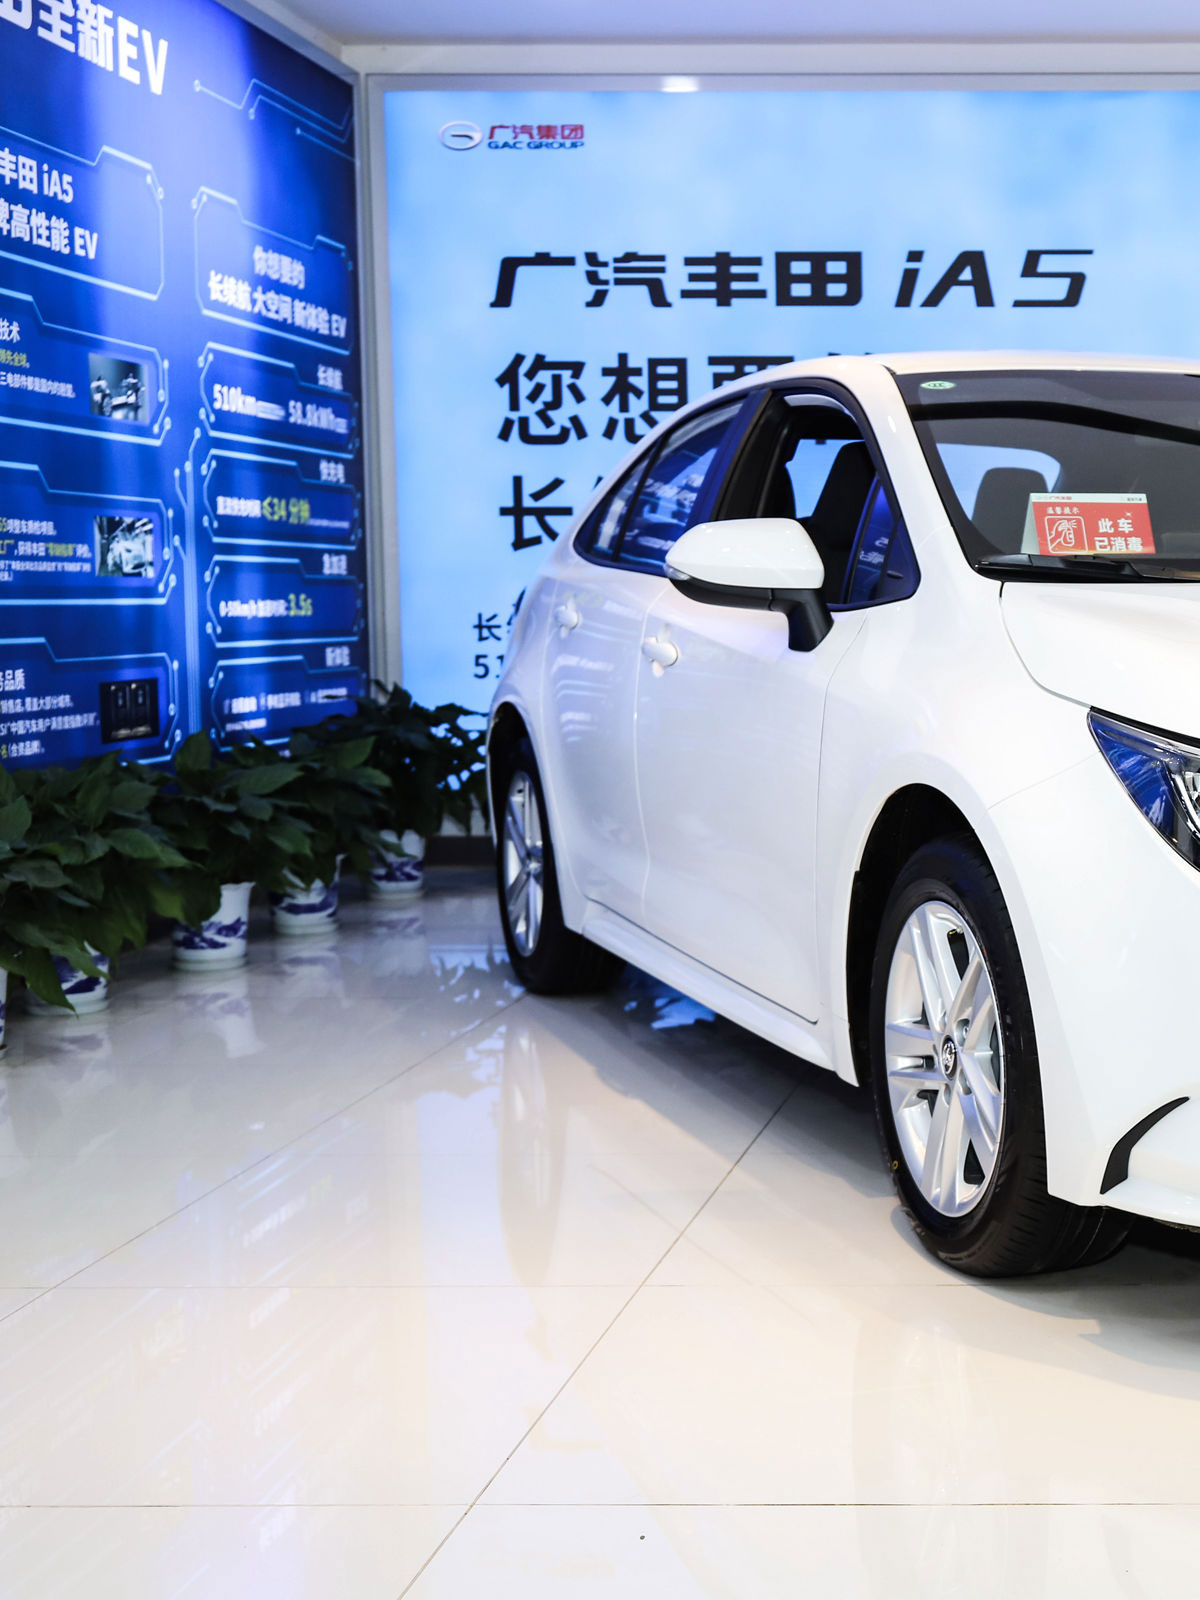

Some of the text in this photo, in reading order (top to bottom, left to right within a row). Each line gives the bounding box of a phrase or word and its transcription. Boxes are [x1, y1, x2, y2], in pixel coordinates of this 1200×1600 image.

[487, 140, 584, 150] GAC GROUP
[488, 124, 584, 140] 广汽集团
[42, 163, 74, 203] iA5
[74, 226, 98, 260] EV
[490, 248, 1094, 308] 广汽丰田 iA5
[495, 353, 793, 445] 您想
[1094, 536, 1144, 552] 已消毒
